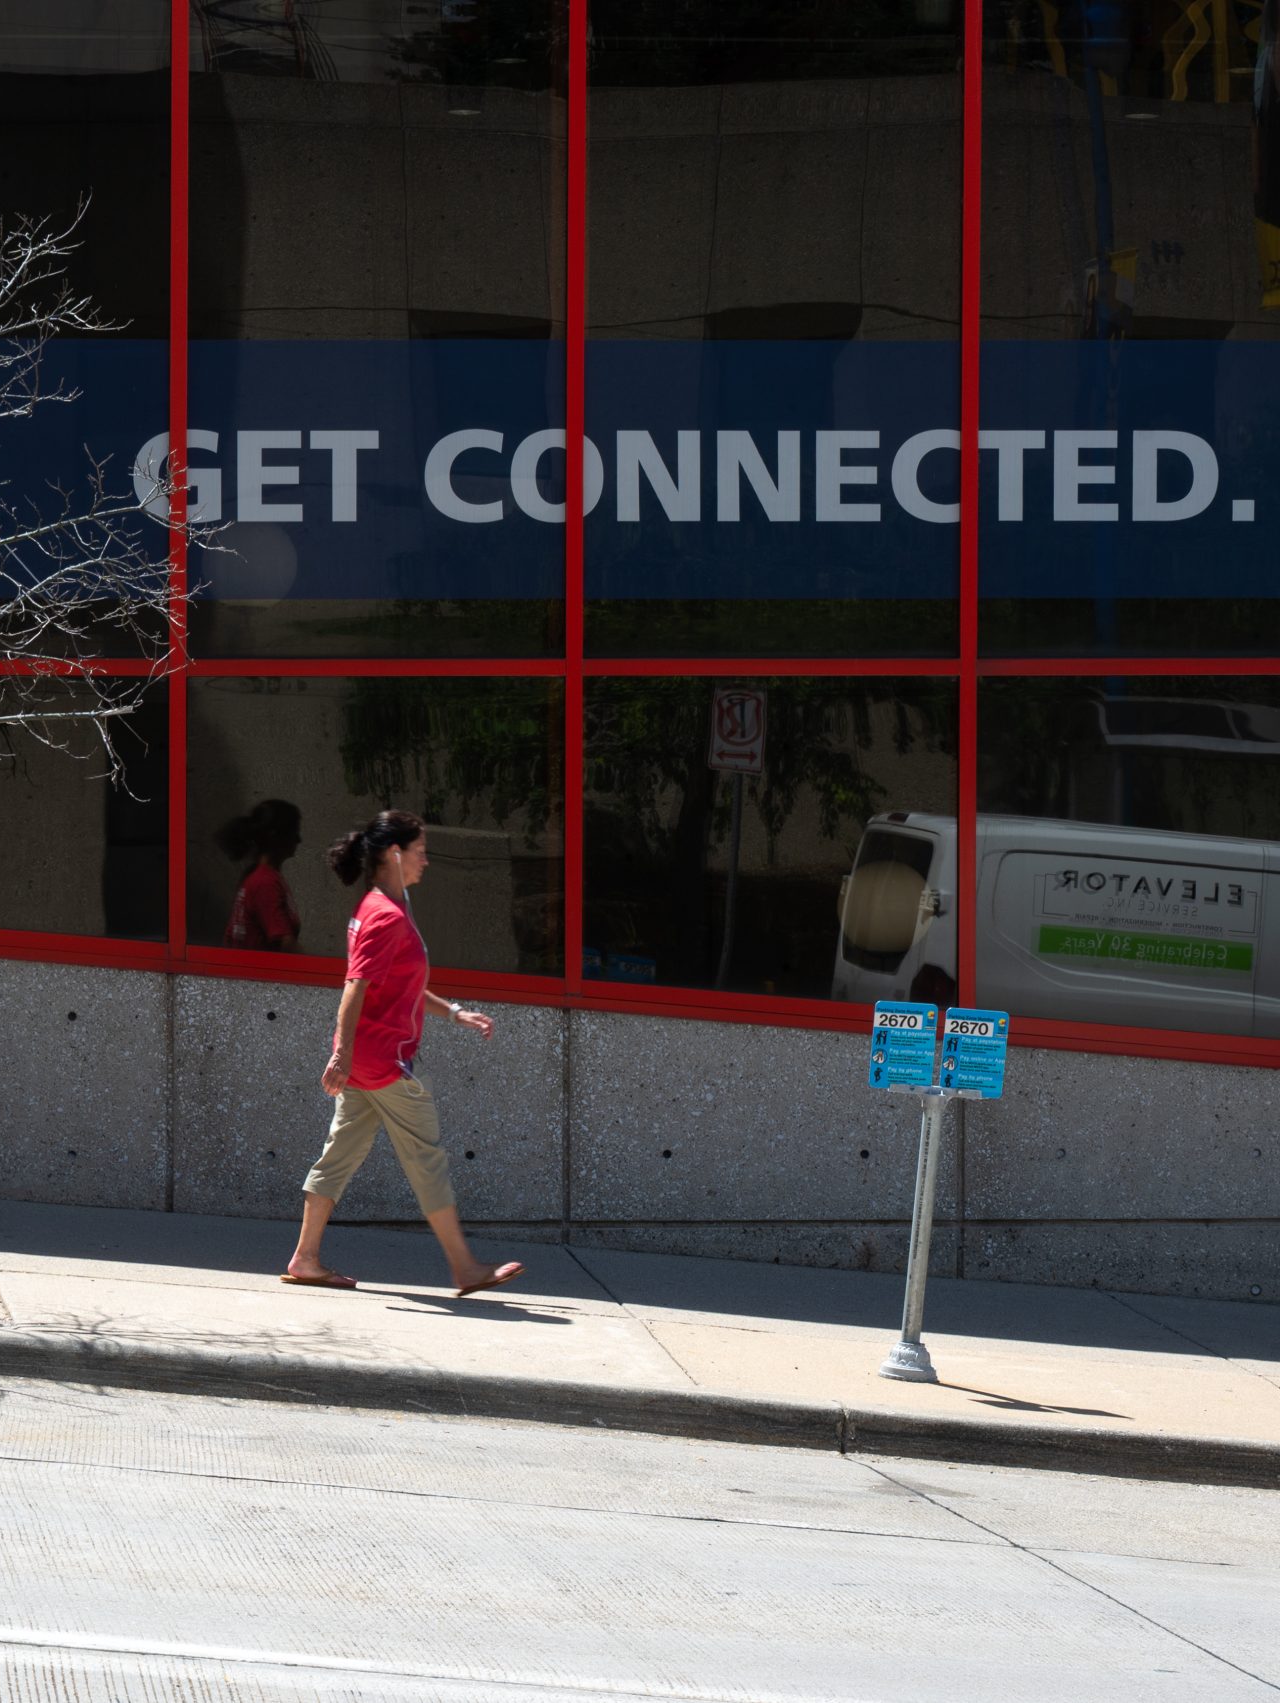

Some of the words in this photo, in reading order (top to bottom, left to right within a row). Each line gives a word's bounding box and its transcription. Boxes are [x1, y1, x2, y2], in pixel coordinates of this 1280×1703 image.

[133, 427, 379, 524] GET
[423, 427, 1256, 524] CONNECTED.
[879, 1014, 917, 1028] 2670
[950, 1020, 988, 1035] 2670
